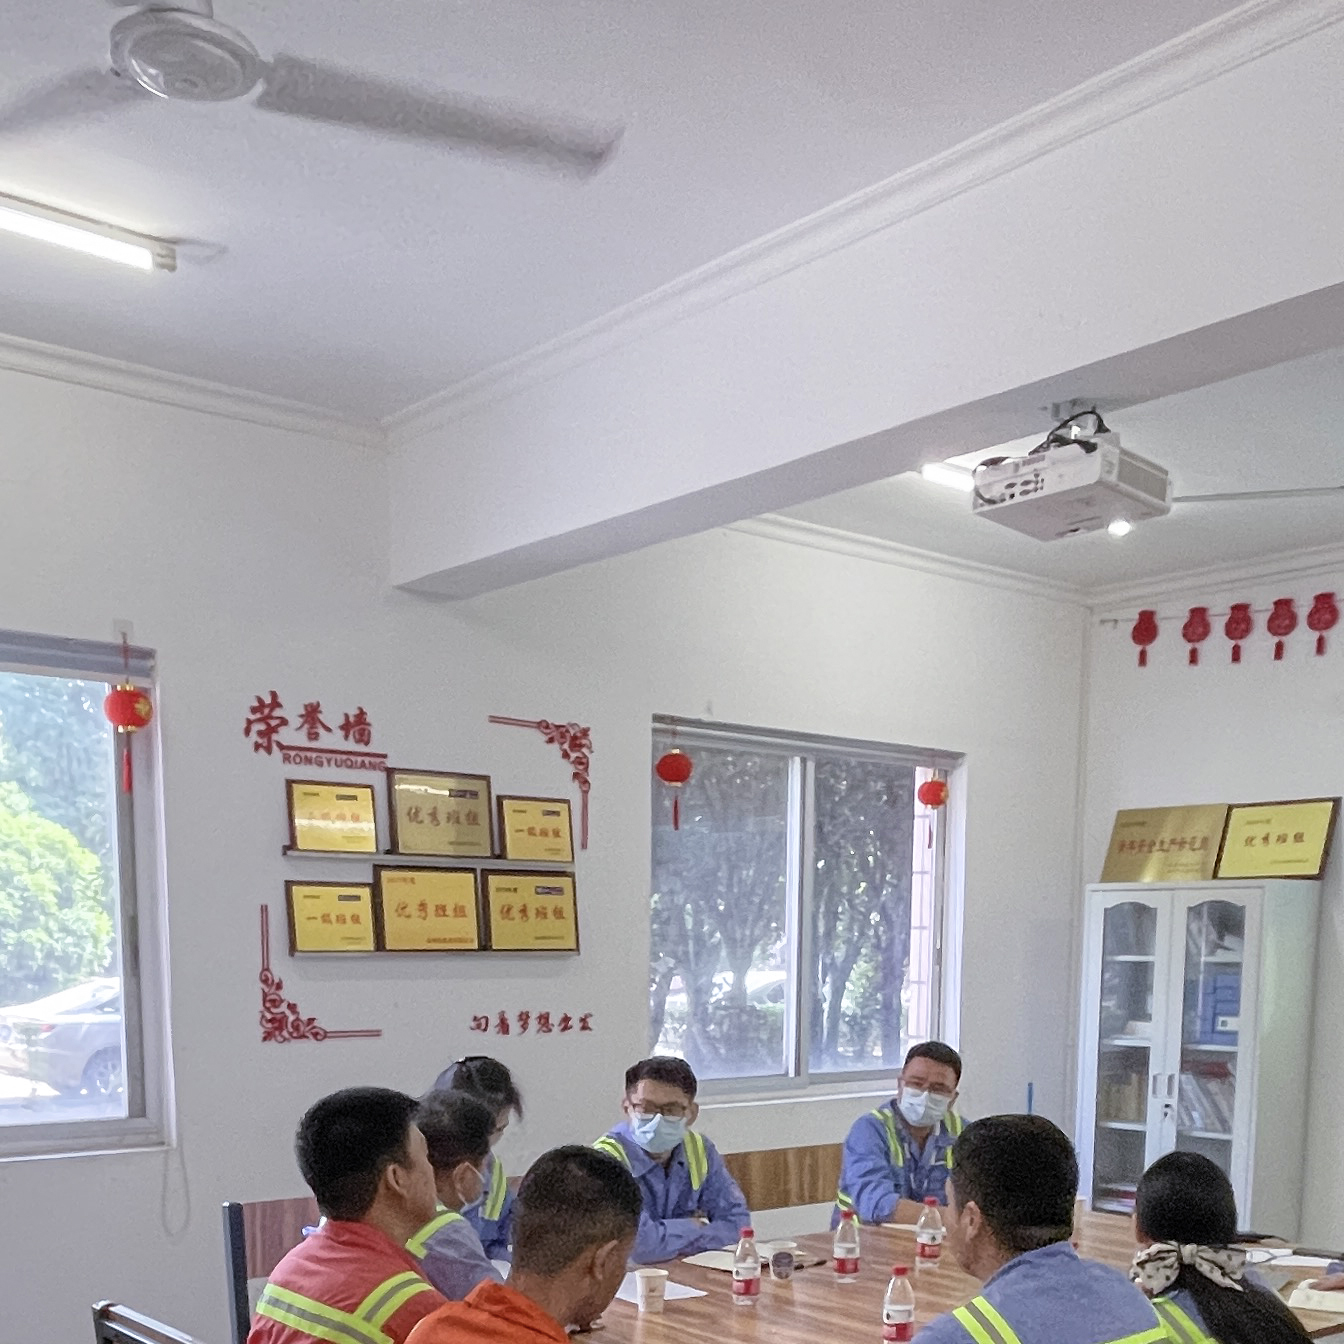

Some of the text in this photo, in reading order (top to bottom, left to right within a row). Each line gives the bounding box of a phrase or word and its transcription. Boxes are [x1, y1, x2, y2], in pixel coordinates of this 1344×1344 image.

[244, 690, 372, 755] 荣誉墙
[282, 753, 387, 771] RONGYUQIANG
